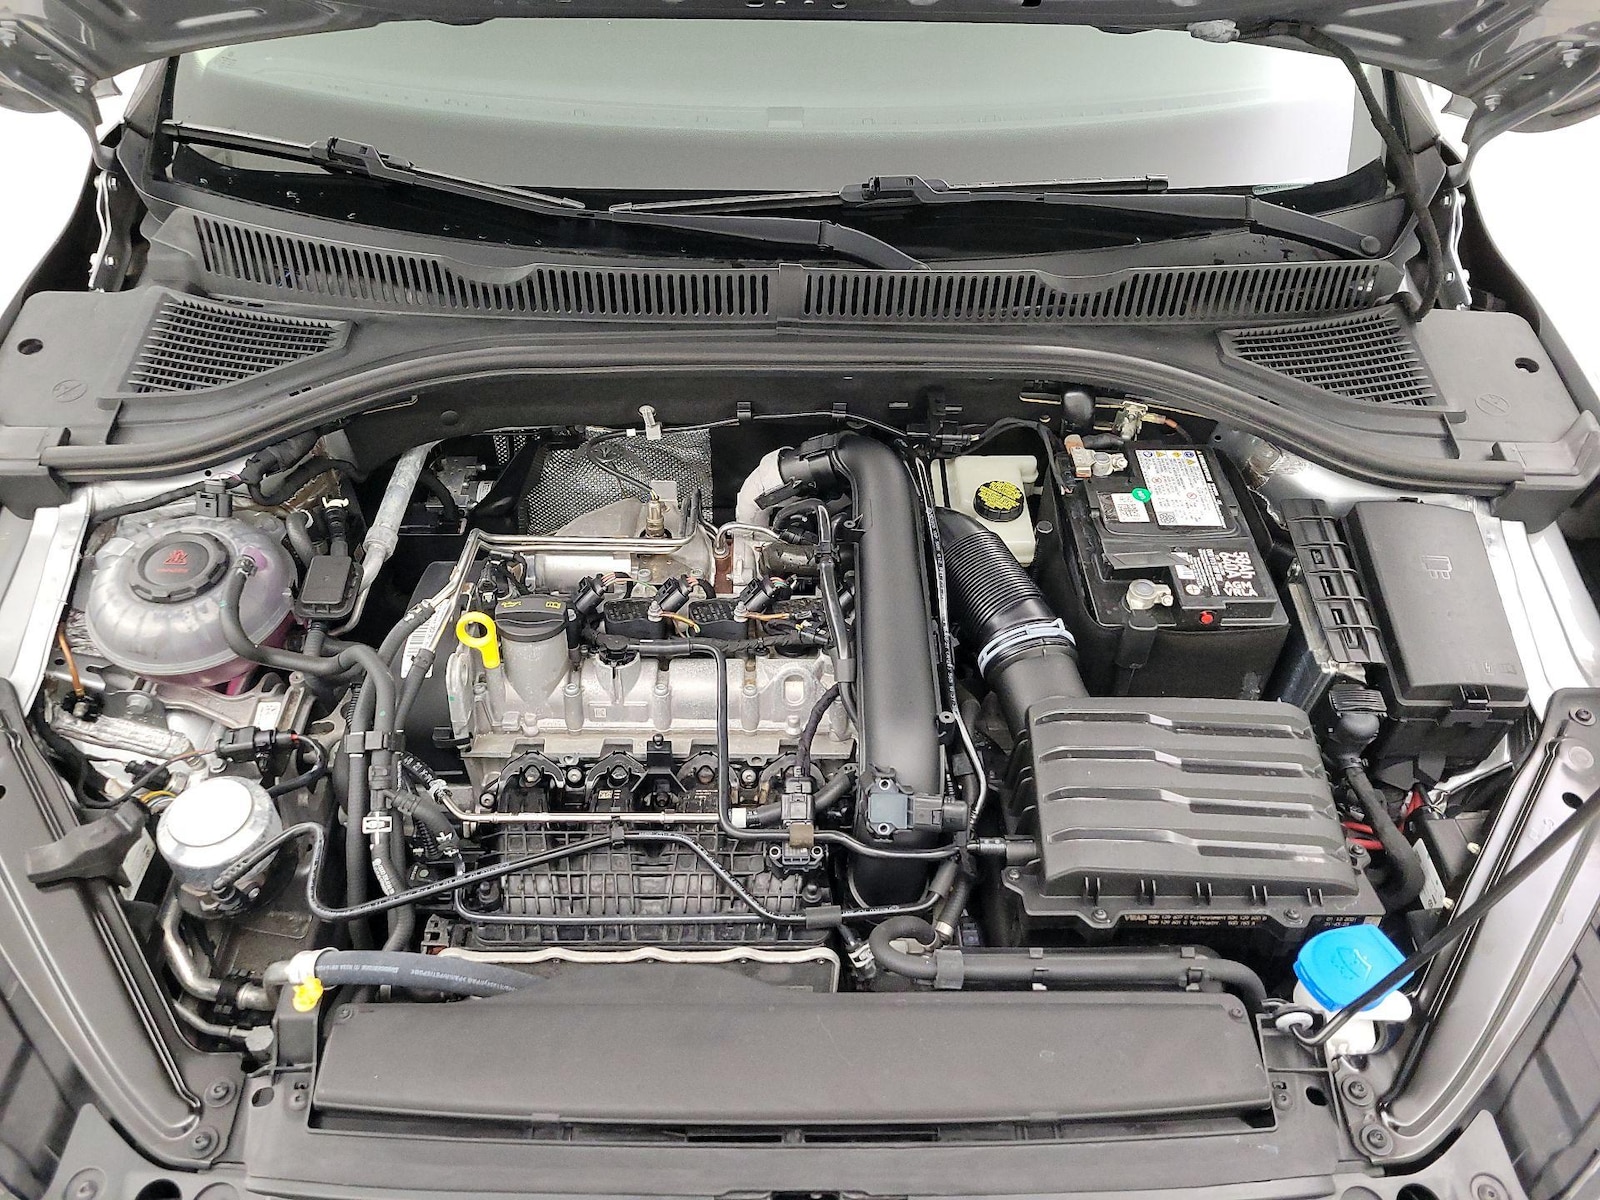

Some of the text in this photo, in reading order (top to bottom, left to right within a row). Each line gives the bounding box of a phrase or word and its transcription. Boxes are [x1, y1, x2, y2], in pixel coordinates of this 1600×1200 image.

[1233, 551, 1256, 579] 58Ah
[1224, 580, 1253, 589] AGM
[1222, 587, 1259, 597] VRLA
